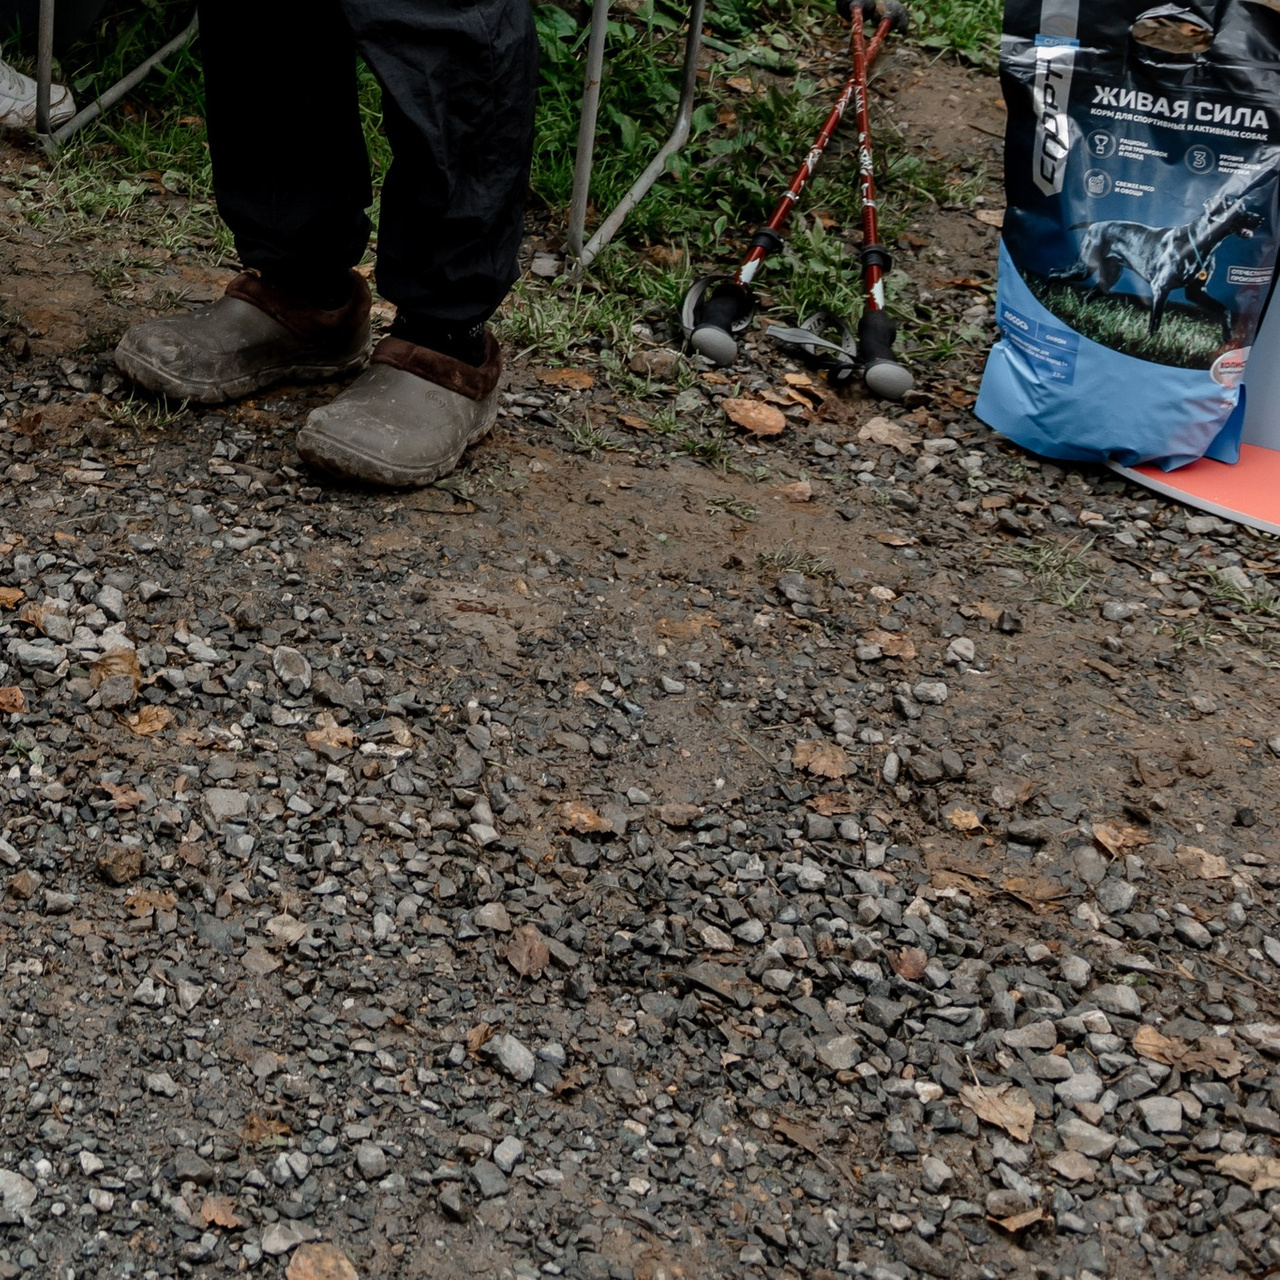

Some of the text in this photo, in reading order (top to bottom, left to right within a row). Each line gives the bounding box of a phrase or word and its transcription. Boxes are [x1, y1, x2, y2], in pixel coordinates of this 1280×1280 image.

[1039, 59, 1069, 186] СПОРТ
[1089, 107, 1115, 118] КОРМ
[1114, 111, 1133, 120] ДЛЯ
[1133, 114, 1186, 131] СПОРТИВНЫХ
[1194, 124, 1240, 138] АКТИВНЫХ
[1240, 131, 1269, 142] СОБАК
[1091, 84, 1270, 130] ЖИВАЯ СИЛА
[1193, 150, 1207, 169] 3
